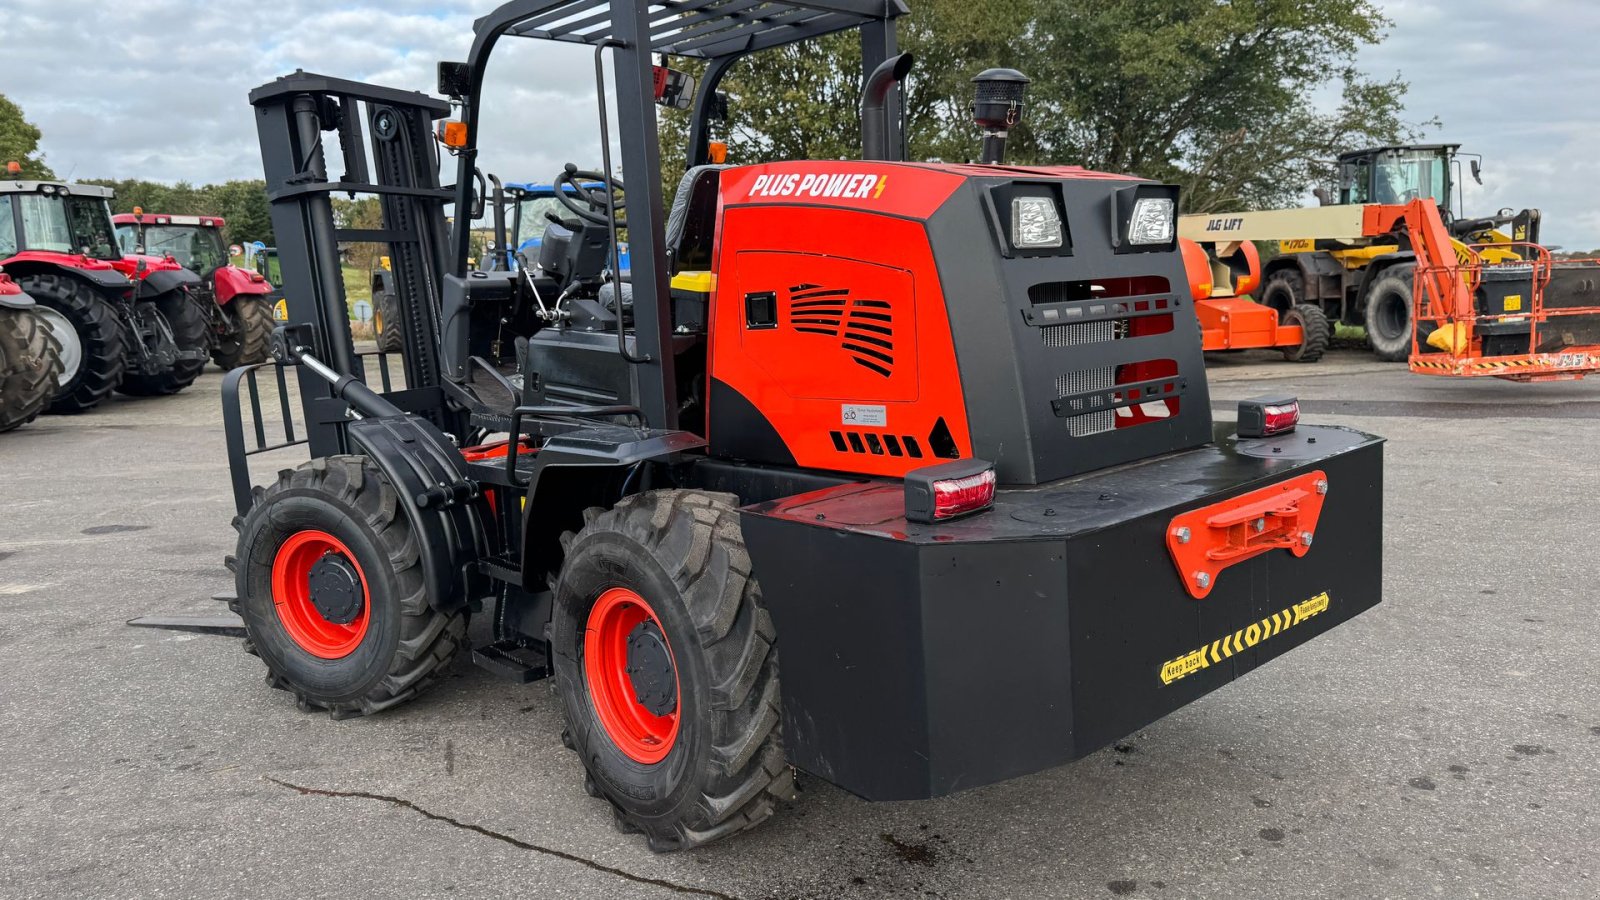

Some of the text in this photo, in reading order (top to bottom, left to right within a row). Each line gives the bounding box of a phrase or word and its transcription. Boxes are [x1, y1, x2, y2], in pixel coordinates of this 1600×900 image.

[748, 174, 878, 198] PLUS POWER
[1206, 218, 1244, 231] JLG LIFT
[1167, 655, 1200, 676] Keep back
